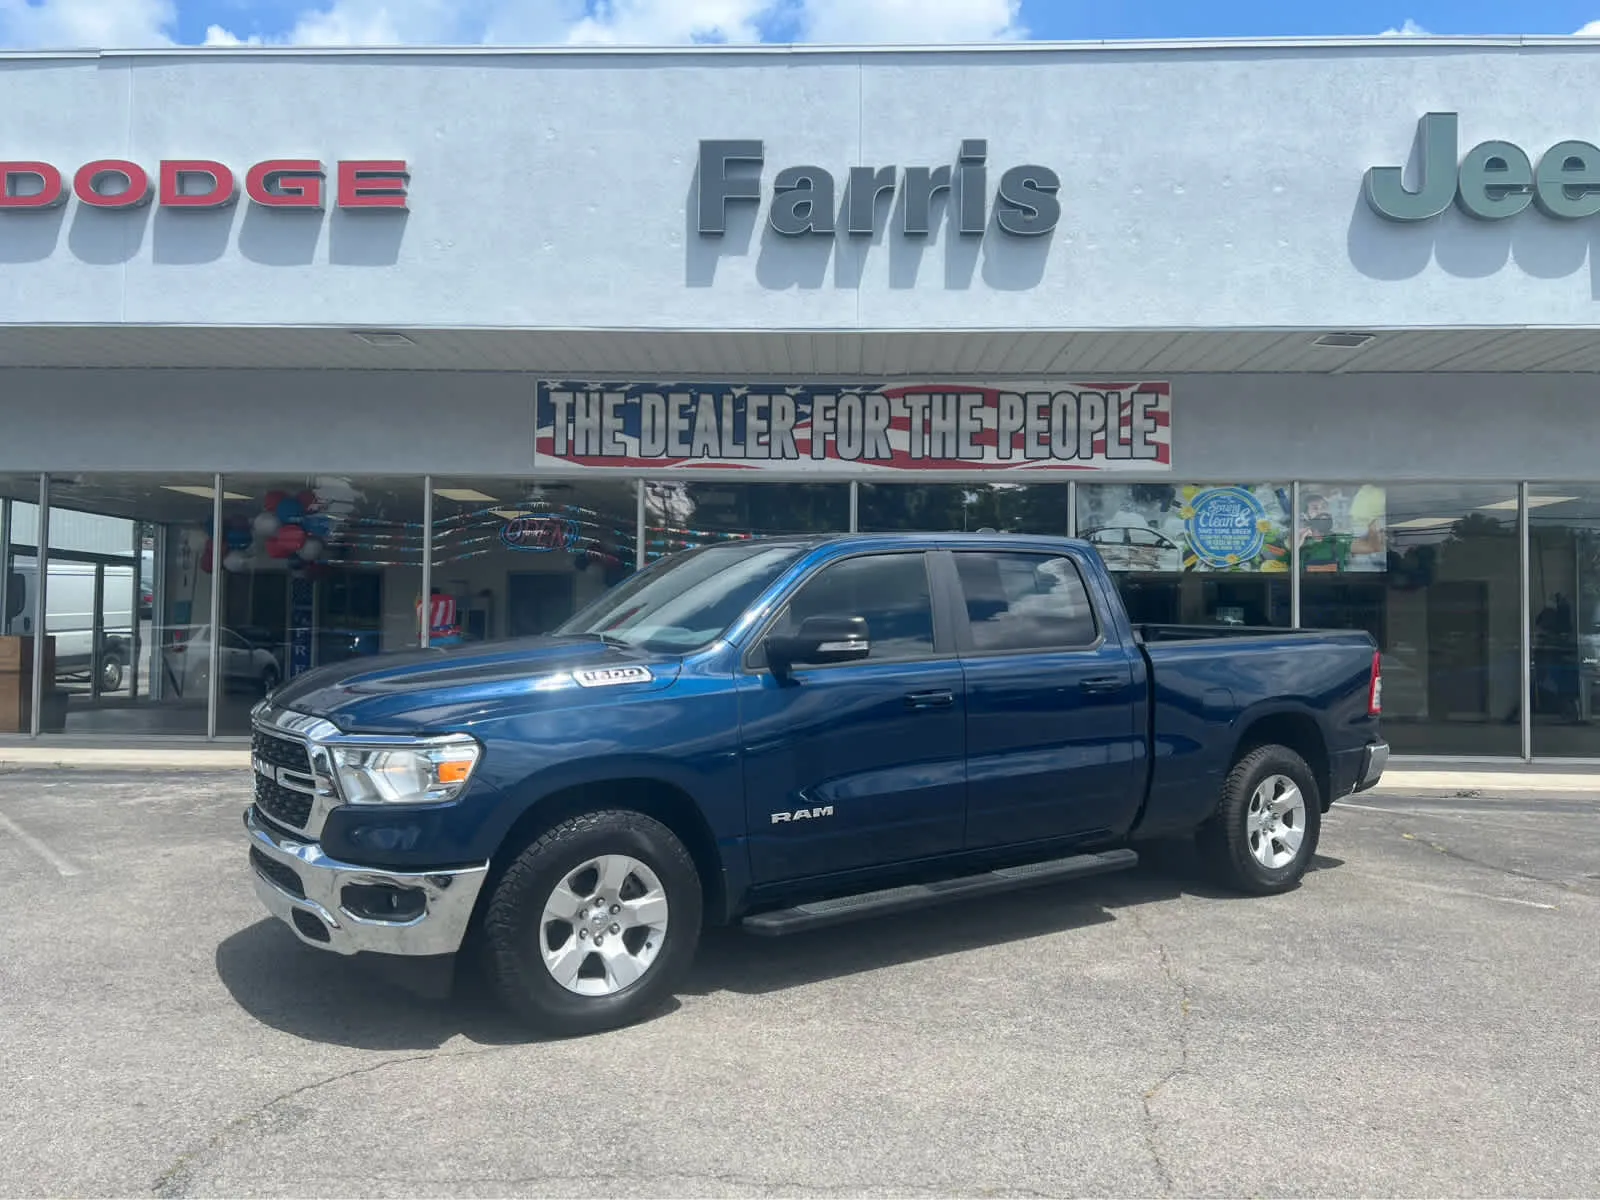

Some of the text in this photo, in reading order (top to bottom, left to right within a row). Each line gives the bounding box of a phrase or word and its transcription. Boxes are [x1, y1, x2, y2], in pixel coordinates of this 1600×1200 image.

[0, 159, 411, 211] DODGE
[697, 139, 1061, 235] Farris
[549, 391, 1159, 461] THE DEALER FOR THE PEOPLE
[506, 518, 573, 549] OPEN
[1198, 511, 1234, 528] Clean
[771, 806, 834, 824] RAM
